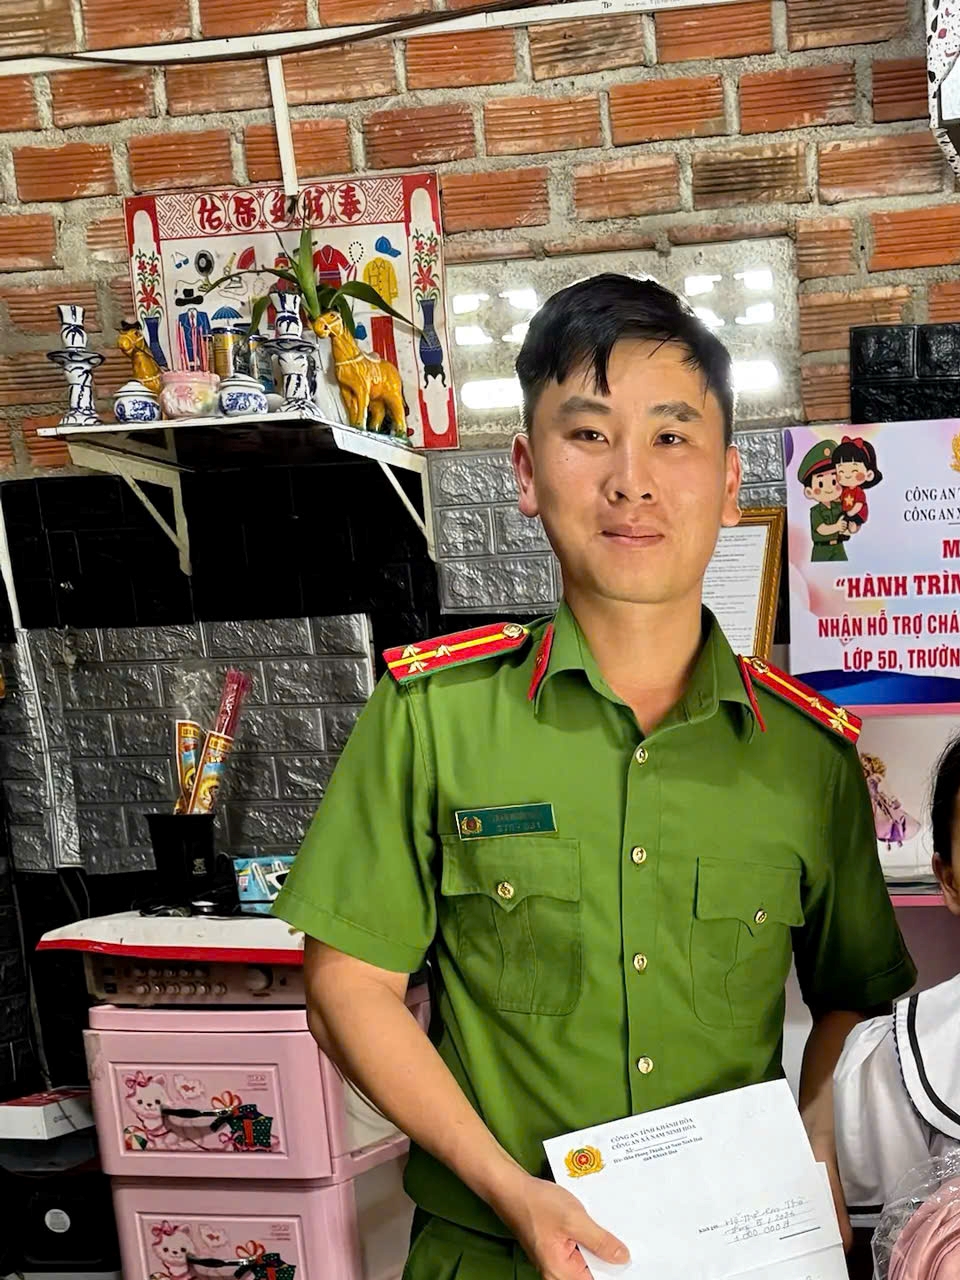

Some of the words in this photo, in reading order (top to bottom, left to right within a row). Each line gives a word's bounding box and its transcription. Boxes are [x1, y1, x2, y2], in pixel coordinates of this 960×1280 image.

[905, 486, 937, 502] CÔNG
[940, 488, 956, 500] AN
[904, 507, 936, 522] CÔNG
[938, 508, 954, 520] AN
[818, 614, 862, 642] NHẬN
[867, 609, 888, 636] HỖ
[892, 613, 923, 639] TRỢ
[843, 647, 873, 671] LỚP
[878, 650, 903, 671] 5D,
